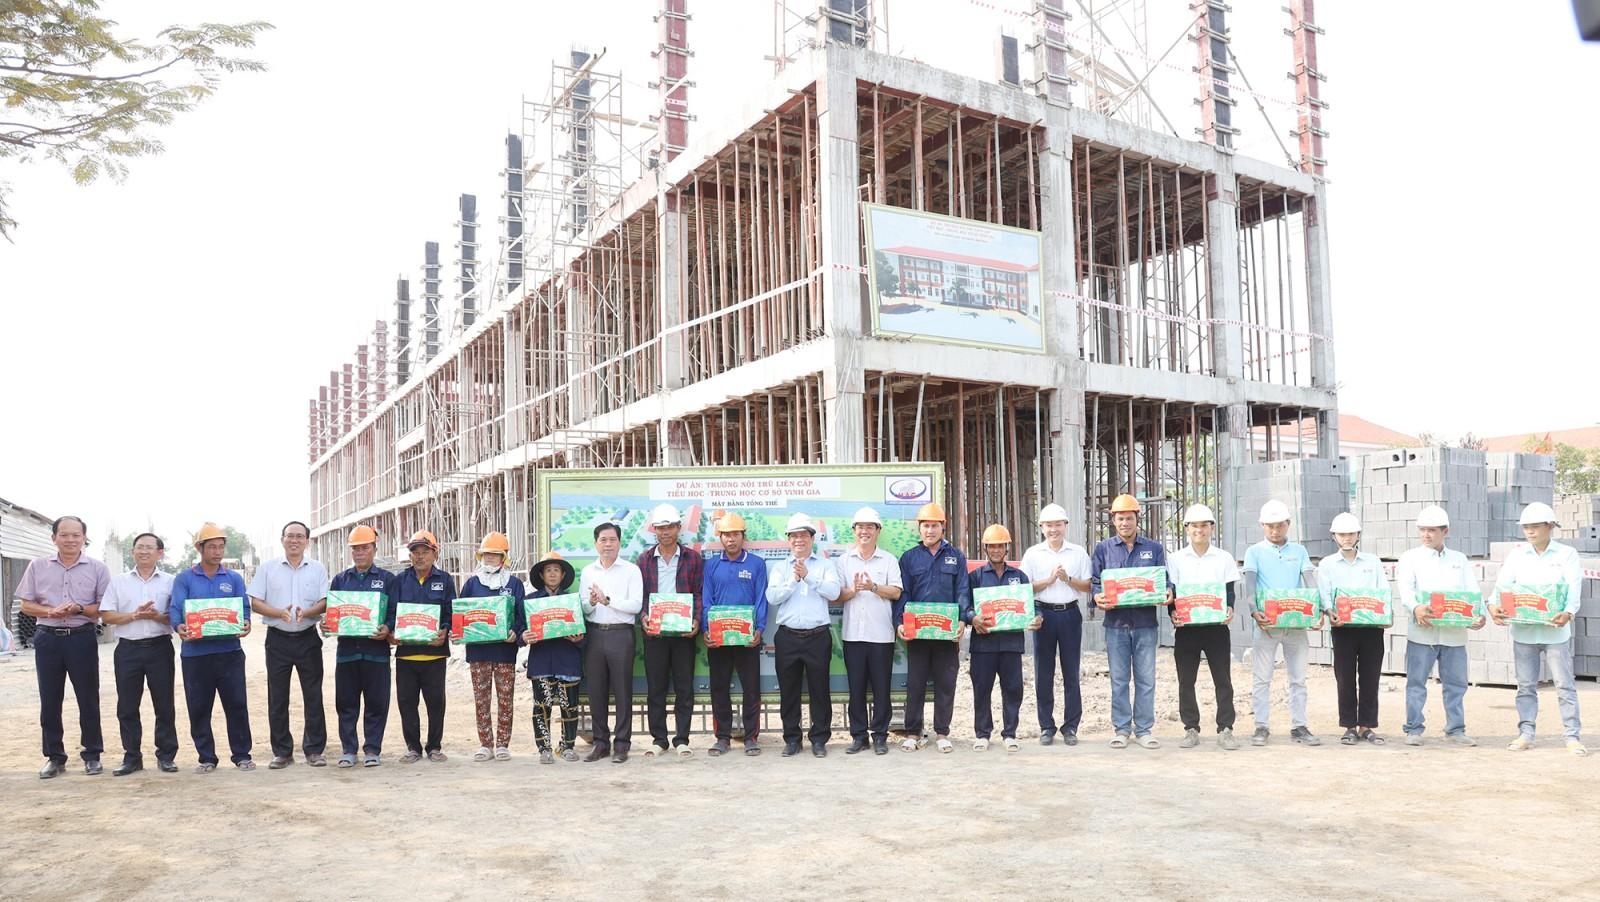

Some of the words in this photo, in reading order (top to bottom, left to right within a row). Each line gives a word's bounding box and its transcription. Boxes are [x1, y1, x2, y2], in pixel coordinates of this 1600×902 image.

[740, 479, 755, 489] NỘI
[776, 479, 795, 487] LIÊN
[797, 478, 814, 487] CẤP
[688, 490, 705, 498] HỌC
[710, 489, 737, 497] TRUNG
[739, 489, 757, 498] HỌC
[758, 488, 770, 496] CƠ
[771, 487, 782, 496] SỞ
[806, 488, 821, 496] GIA
